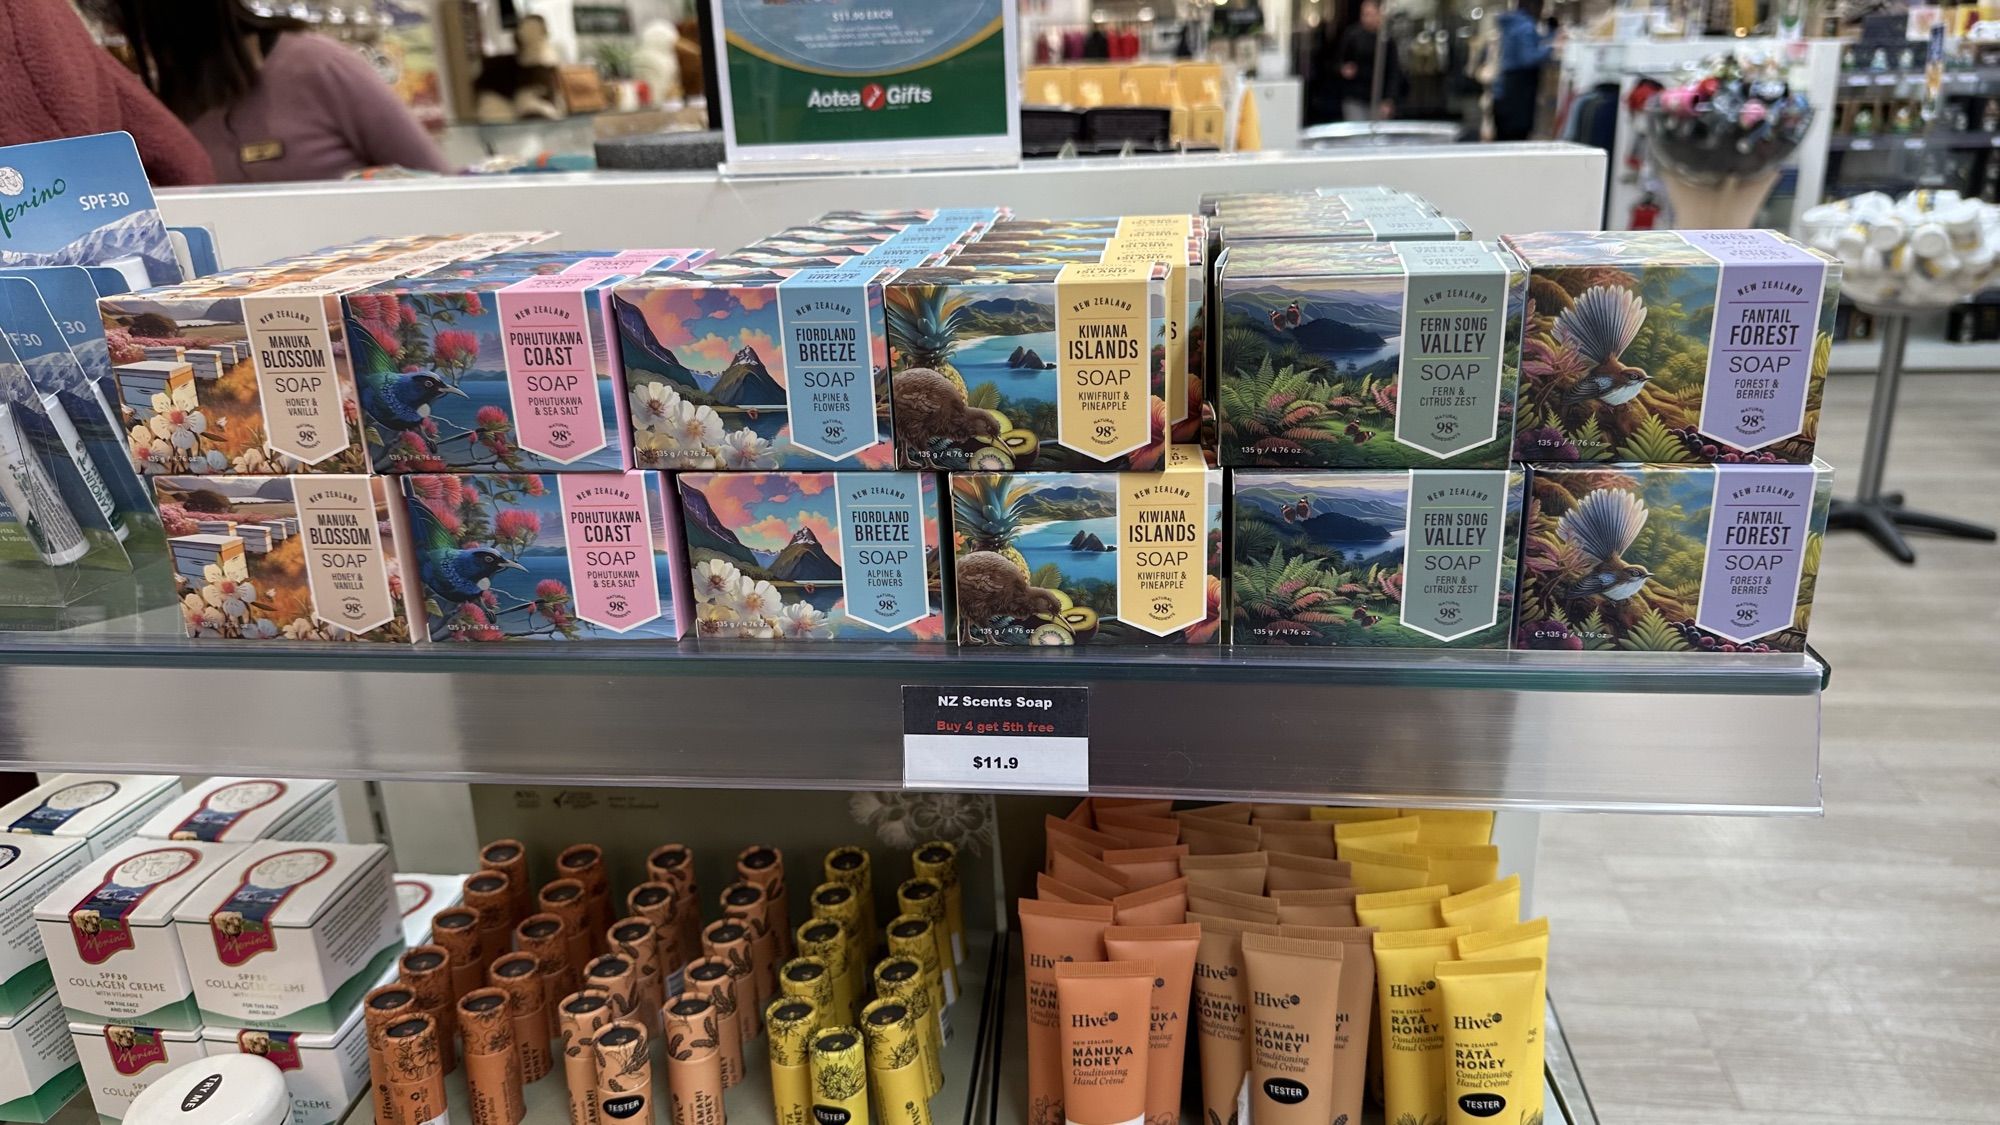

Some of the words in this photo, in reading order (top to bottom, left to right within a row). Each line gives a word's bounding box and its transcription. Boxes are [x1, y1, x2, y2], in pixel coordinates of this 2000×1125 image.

[808, 90, 860, 108] Aotea
[887, 86, 932, 104] Gifts
[79, 193, 106, 211] SPF
[109, 192, 130, 206] 30
[1737, 284, 1758, 296] NEW
[1762, 281, 1803, 296] ZEALAND
[1424, 291, 1443, 304] NEW
[1448, 289, 1488, 304] ZEALAND
[796, 303, 812, 316] NEW
[815, 302, 851, 315] ZEALAND
[1073, 300, 1090, 313] NEW
[1094, 298, 1132, 311] ZEALAND
[260, 312, 275, 324] NEW
[276, 310, 309, 323] ZEALAND
[515, 307, 531, 320] NEW
[534, 306, 570, 319] ZEALAND
[1742, 309, 1791, 323] FANTAIL
[1079, 324, 1128, 338] KIWIANA
[1420, 317, 1450, 332] FERN
[1455, 317, 1487, 331] SONG
[510, 332, 583, 345] POHUTUKAWA
[796, 328, 855, 341] FIORDLAND
[1730, 325, 1800, 346] FOREST
[269, 336, 312, 348] MANUKA
[1420, 334, 1486, 353] VALLEY
[800, 343, 856, 362] BREEZE
[1069, 340, 1138, 360] ISLANDS
[262, 350, 325, 368] BLOSSOM
[524, 348, 572, 366] COAST
[1729, 356, 1790, 373] SOAP
[1077, 370, 1131, 386] SOAP
[1420, 364, 1480, 381] SOAP
[276, 378, 321, 392] SOAP
[527, 376, 578, 392] SOAP
[804, 372, 855, 388] SOAP
[1735, 379, 1770, 389] FOREST
[1772, 379, 1779, 388] &
[813, 393, 840, 402] ALPINE
[843, 393, 848, 401] &
[1078, 391, 1121, 401] KIWIFRUIT
[1124, 392, 1129, 400] &
[1432, 387, 1456, 396] FERN
[1458, 386, 1464, 396] &
[1736, 390, 1774, 399] BERRIES
[529, 397, 582, 406] POHUTUKAWA
[814, 403, 850, 412] FLOWERS
[1082, 401, 1127, 411] PINEAPPLE
[1420, 397, 1451, 406] CITRUS
[1454, 397, 1476, 406] ZEST
[288, 408, 318, 416] VANILLA
[535, 407, 540, 415] &
[542, 407, 558, 416] SEA
[561, 406, 578, 415] SALT
[1096, 425, 1116, 437] 98%
[1437, 421, 1459, 434] 98%
[83, 470, 111, 513] LANOLIN
[576, 490, 592, 500] NEW
[595, 488, 630, 500] ZEALAND
[852, 490, 868, 500] NEW
[871, 488, 905, 500] ZEALAND
[1134, 488, 1151, 499] NEW
[1155, 486, 1190, 498] ZEALAND
[1427, 490, 1445, 501] NEW
[1450, 488, 1487, 501] ZEALAND
[1733, 488, 1752, 500] NEW
[1755, 486, 1794, 499] ZEALAND
[317, 515, 358, 526] MANUKA
[571, 511, 641, 524] POHUTUKAWA
[852, 511, 909, 523] FIORDLAND
[1139, 511, 1185, 522] KIWIANA
[1424, 514, 1452, 526] FERN
[1457, 513, 1487, 526] SONG
[1737, 511, 1784, 524] FANTAIL
[310, 527, 371, 545] BLOSSOM
[585, 525, 631, 542] COAST
[855, 525, 910, 542] BREEZE
[1129, 524, 1195, 542] ISLANDS
[1425, 528, 1486, 546] VALLEY
[1726, 527, 1791, 545] FOREST
[322, 554, 367, 568] SOAP
[586, 552, 636, 566] SOAP
[859, 551, 907, 565] SOAP
[1136, 552, 1188, 567] SOAP
[1425, 556, 1481, 571] SOAP
[1725, 555, 1782, 571] SOAP
[332, 573, 355, 581] HONEY
[587, 571, 639, 579] POHUTUKAWA
[1138, 572, 1179, 580] KIWIFRUIT
[1436, 576, 1458, 584] FERN
[1460, 576, 1466, 584] &
[1730, 576, 1763, 585] FOREST
[1766, 576, 1771, 584] &
[334, 582, 364, 590] VANILLA
[594, 580, 599, 588] &
[601, 580, 616, 588] SEA
[619, 579, 636, 587] SALT
[868, 579, 903, 587] FLOWERS
[1141, 581, 1184, 590] PINEAPPLE
[1424, 585, 1454, 593] CITRUS
[1457, 585, 1477, 593] ZEST
[1732, 586, 1768, 595] BERRIES
[938, 696, 958, 706] NZ
[963, 697, 1012, 707] Scents
[1016, 697, 1052, 710] Soap
[937, 721, 961, 732] Buy
[965, 721, 973, 730] 4
[977, 722, 999, 733] get
[1002, 722, 1023, 732] 5th
[1028, 722, 1054, 732] free
[973, 756, 1018, 769] $11.9
[69, 978, 125, 991] COLLAGEN
[130, 982, 166, 992] CREME
[1254, 992, 1290, 1009] Hive
[1072, 1015, 1108, 1027] Hive
[1454, 1016, 1492, 1029] Hive
[1073, 1046, 1133, 1056] MĀNUKA
[1256, 1038, 1301, 1052] HONEY
[1073, 1057, 1120, 1066] HONEY
[1256, 1049, 1309, 1064] Conditioning
[1256, 1059, 1278, 1069] Hand
[1456, 1060, 1505, 1069] HONEY
[1073, 1068, 1128, 1077] Conditioning
[1456, 1070, 1512, 1078] Conditioning
[200, 1077, 219, 1092] TRY
[1456, 1079, 1482, 1088] Hand
[1484, 1078, 1509, 1088] Crème
[1269, 1085, 1302, 1096] TESTER
[185, 1095, 203, 1107] ME
[1465, 1100, 1500, 1109] TESTER
